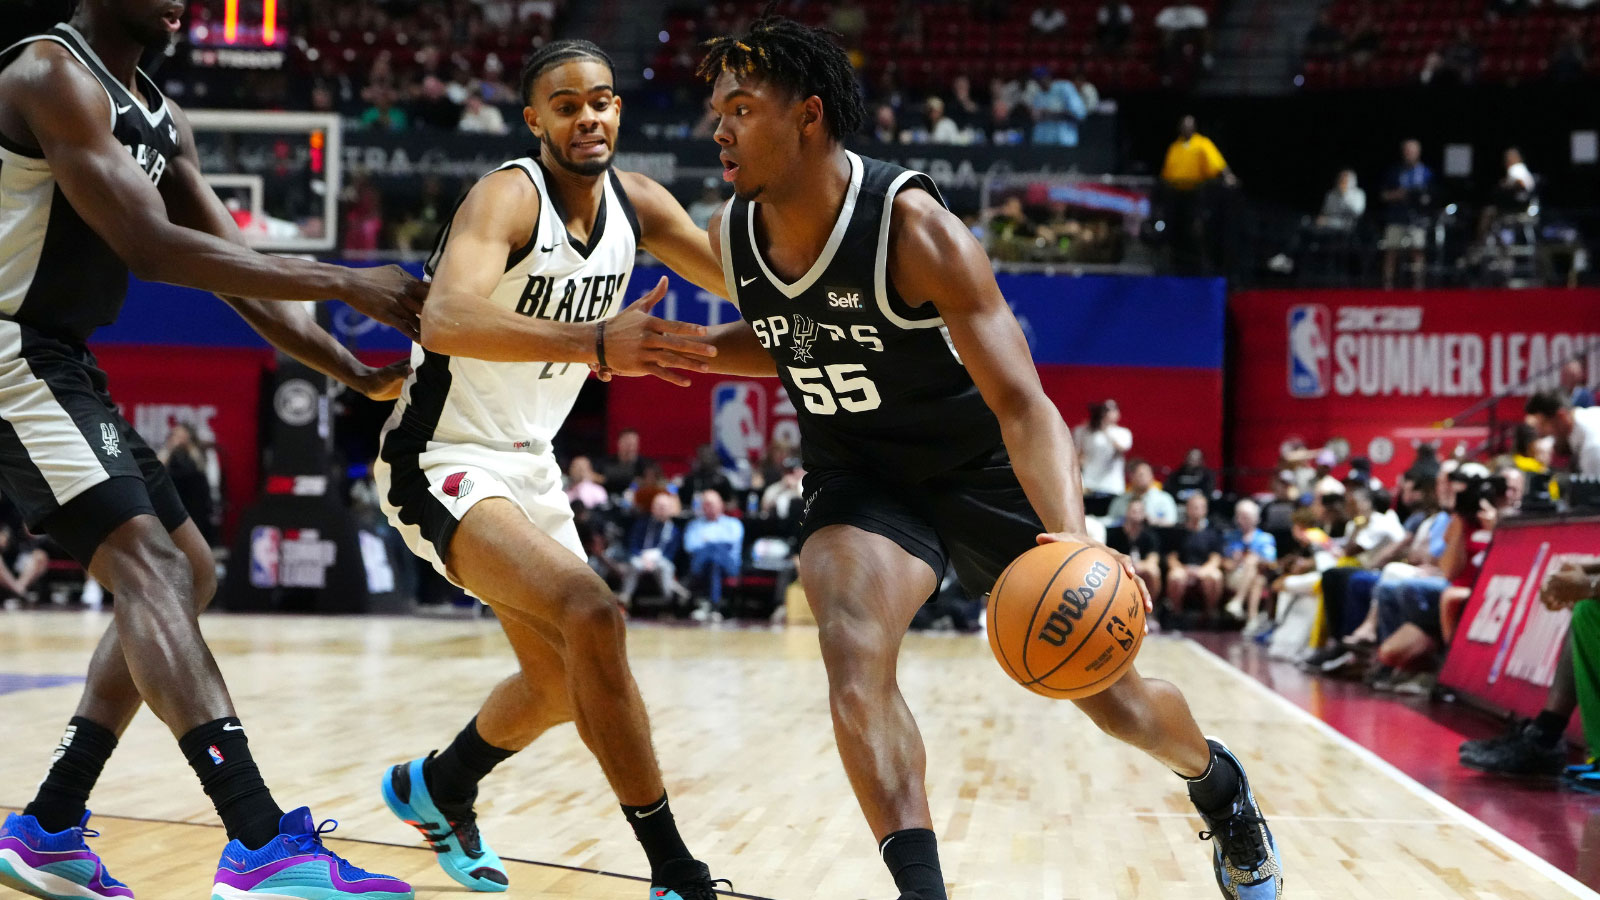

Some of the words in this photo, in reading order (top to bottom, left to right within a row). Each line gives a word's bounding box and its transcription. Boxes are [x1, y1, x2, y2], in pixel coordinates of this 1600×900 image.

[786, 364, 882, 416] 55
[1335, 333, 1483, 396] SUMMER
[1038, 560, 1111, 647] Wilson
